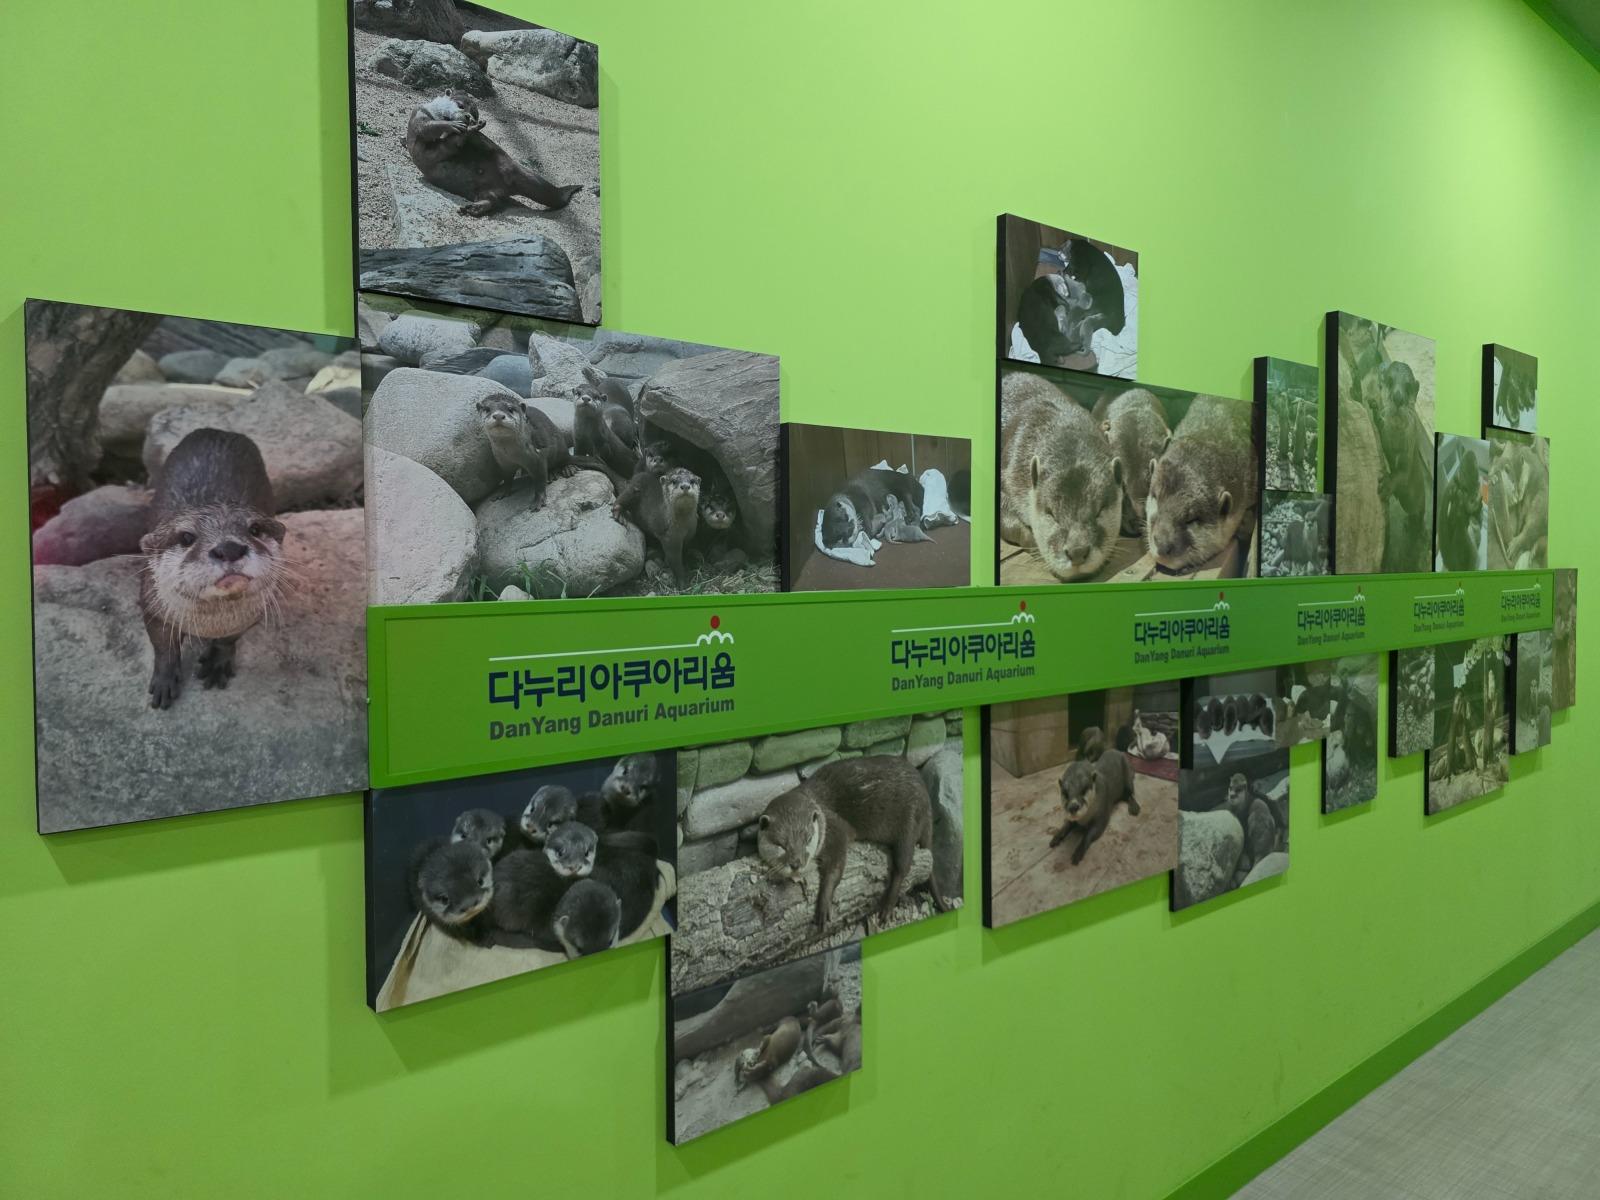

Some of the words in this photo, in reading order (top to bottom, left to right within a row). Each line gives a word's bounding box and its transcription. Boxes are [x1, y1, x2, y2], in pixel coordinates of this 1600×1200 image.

[1134, 615, 1230, 646] 다누리아쿠아리움
[1297, 606, 1366, 631] 다누리아쿠아리움
[891, 629, 1036, 669] 다누리아쿠아리움
[489, 652, 735, 710] 다누리아쿠아리움
[892, 675, 944, 691] DanYang
[948, 668, 983, 685] Danuri
[986, 664, 1035, 683] Aquarium
[490, 715, 581, 741] DanYang
[588, 705, 649, 729] Danuri
[654, 698, 735, 722] Aquarium
